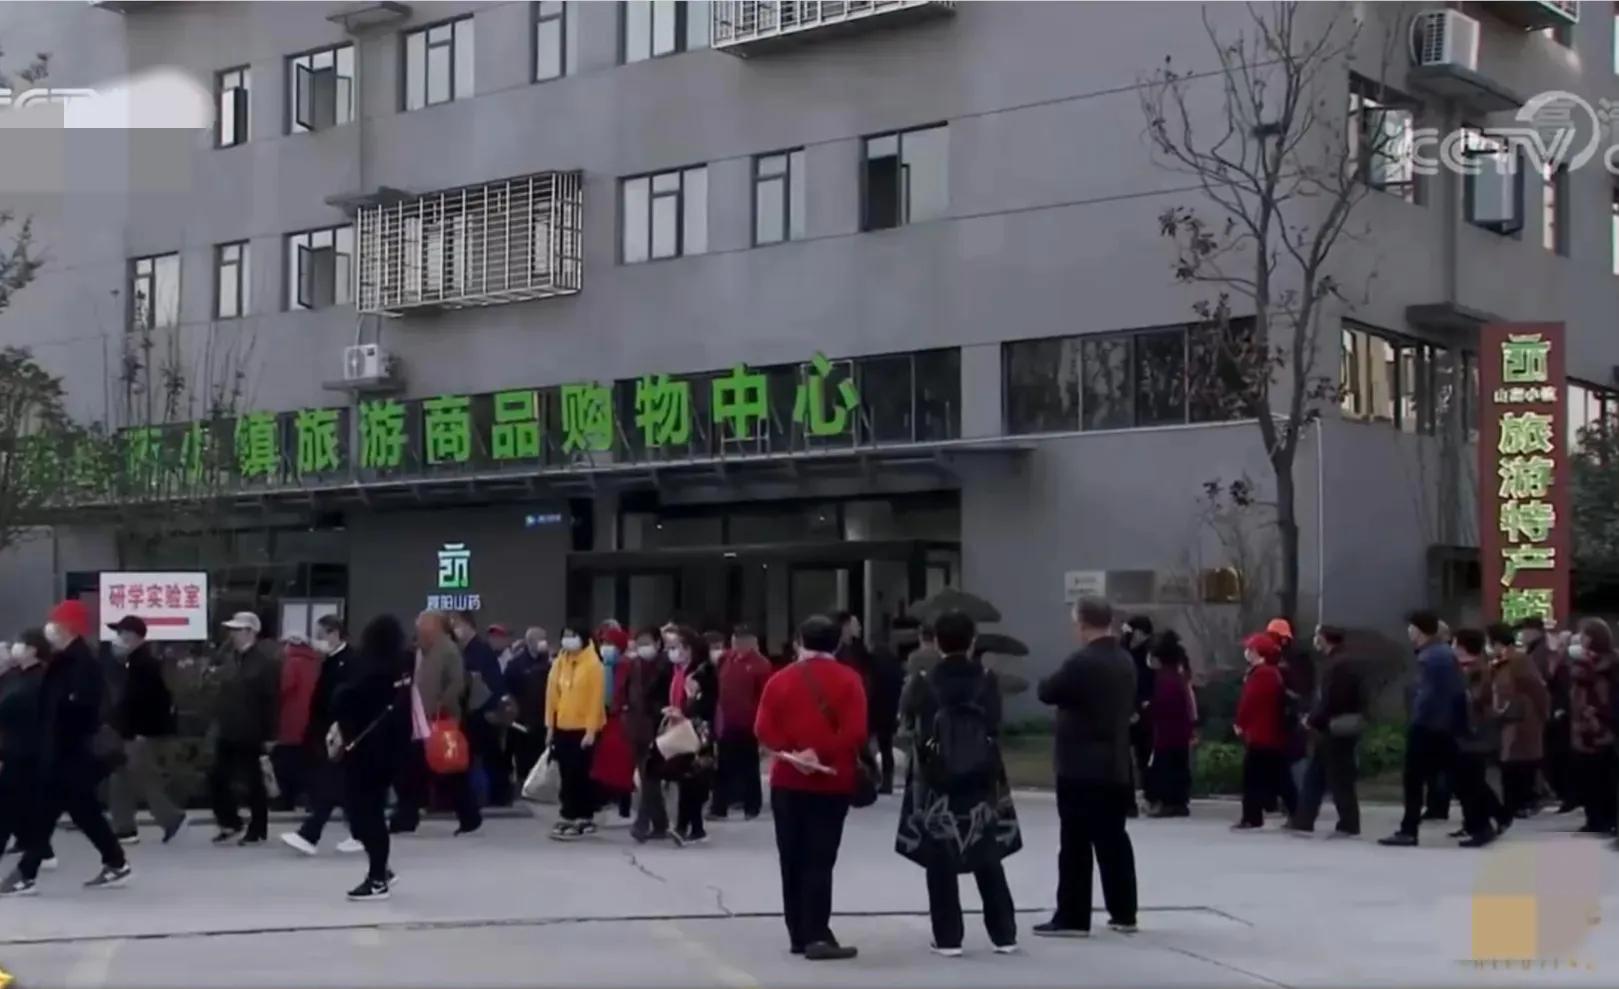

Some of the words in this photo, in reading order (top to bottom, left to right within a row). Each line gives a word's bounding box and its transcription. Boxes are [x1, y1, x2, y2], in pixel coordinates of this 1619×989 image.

[22, 354, 860, 486] 小镇旅游商品购物中心
[108, 583, 201, 610] 研学实验室
